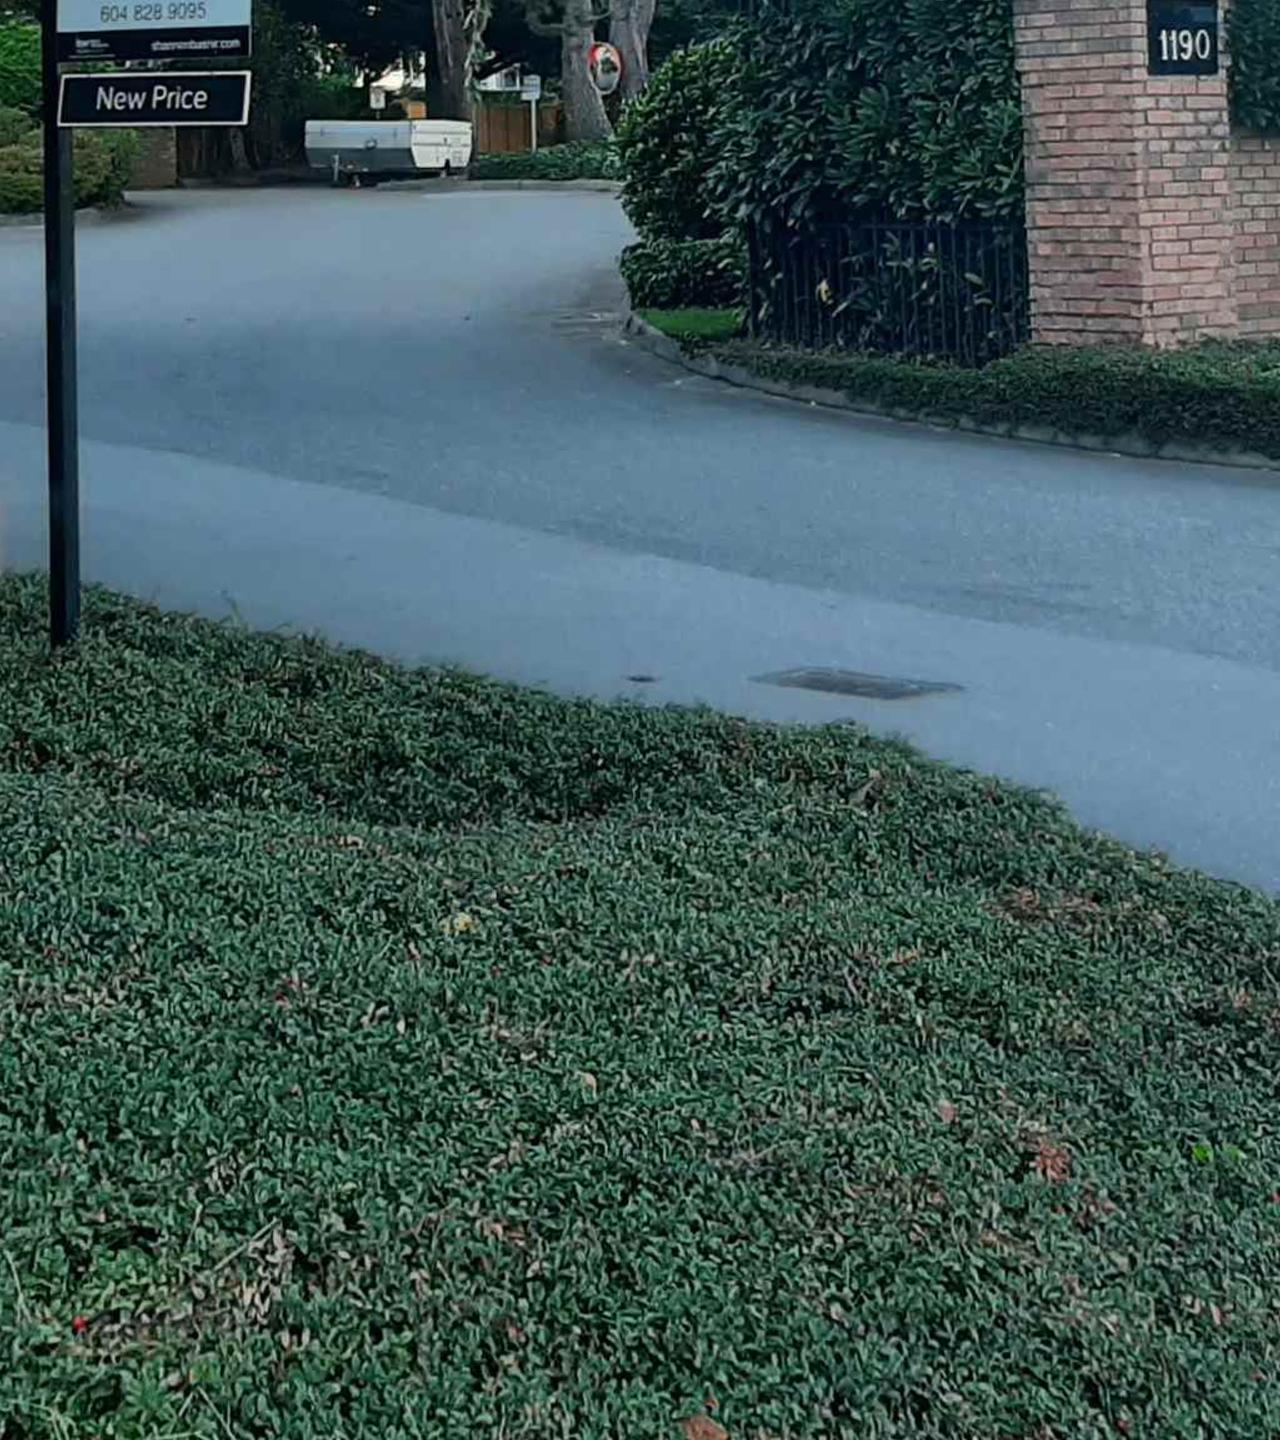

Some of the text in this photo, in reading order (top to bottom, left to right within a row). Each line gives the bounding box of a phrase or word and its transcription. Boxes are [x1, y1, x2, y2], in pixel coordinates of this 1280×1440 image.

[100, 1, 207, 22] 604 828 9095
[1158, 29, 1211, 61] 1190
[96, 85, 208, 111] New Price
